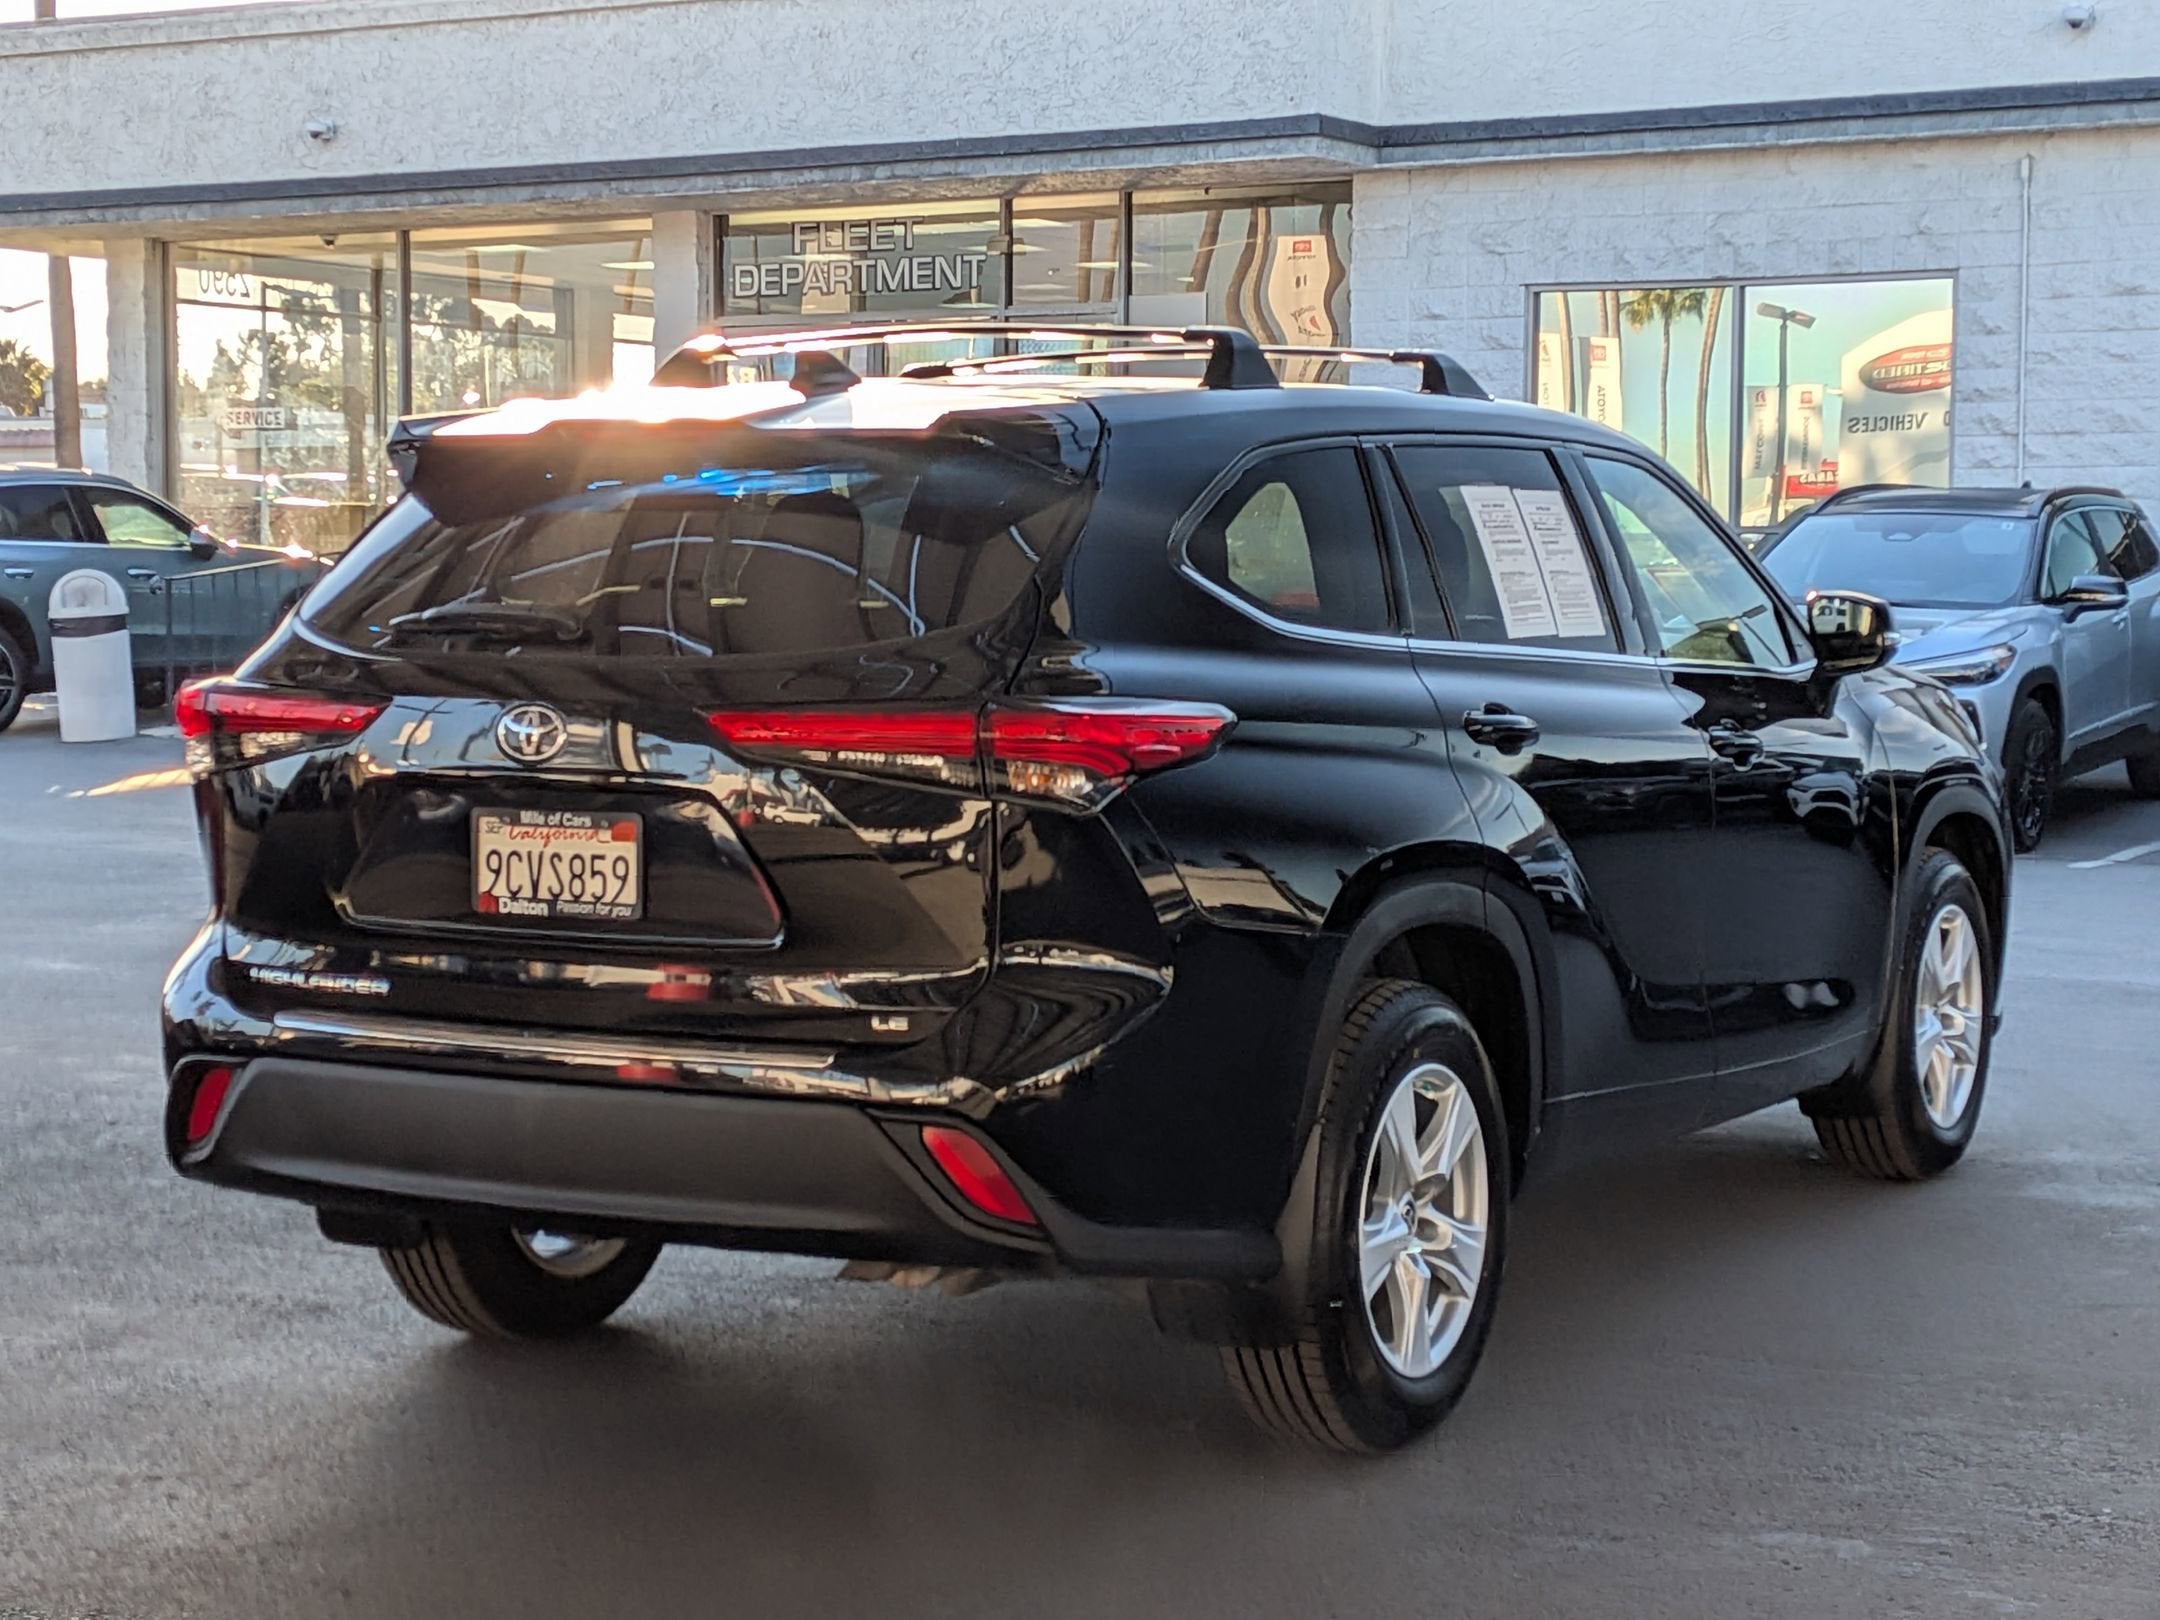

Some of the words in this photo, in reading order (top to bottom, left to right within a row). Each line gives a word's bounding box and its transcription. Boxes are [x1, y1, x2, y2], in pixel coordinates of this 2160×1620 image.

[792, 216, 925, 253] FLEET
[733, 253, 987, 297] DEPARTMENT
[227, 411, 283, 427] SERVICE
[520, 810, 546, 825] Mile
[547, 811, 562, 825] of
[562, 813, 592, 827] Cars
[508, 825, 611, 848] California
[486, 849, 630, 904] 9CVS859
[871, 1016, 909, 1031] LE
